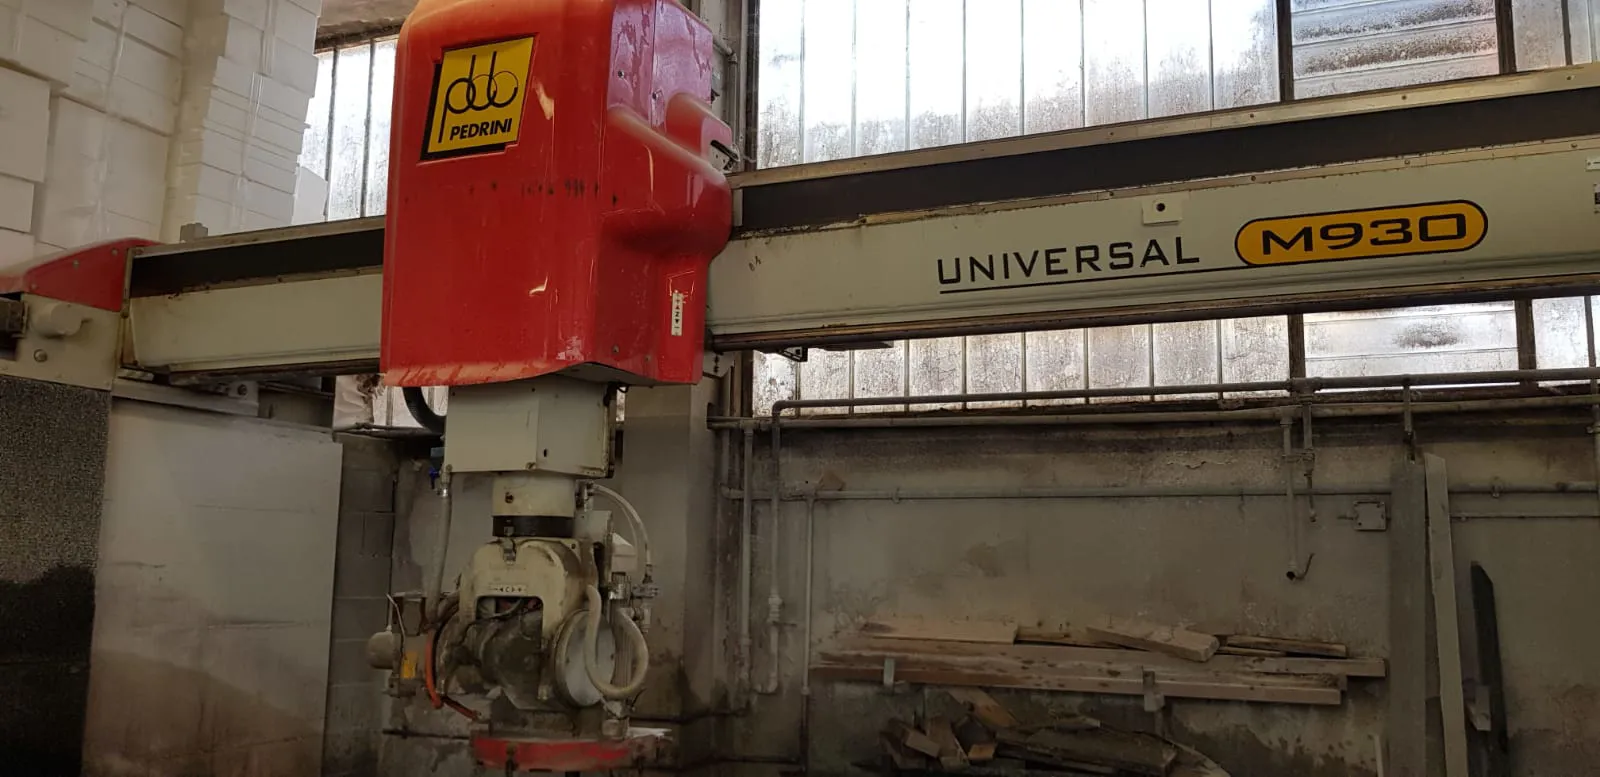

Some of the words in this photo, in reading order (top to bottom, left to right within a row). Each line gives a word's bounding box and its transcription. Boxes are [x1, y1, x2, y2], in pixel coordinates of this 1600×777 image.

[449, 118, 513, 141] PEDRINI
[937, 236, 1200, 285] UNIVERSAL
[1262, 213, 1467, 255] M930
